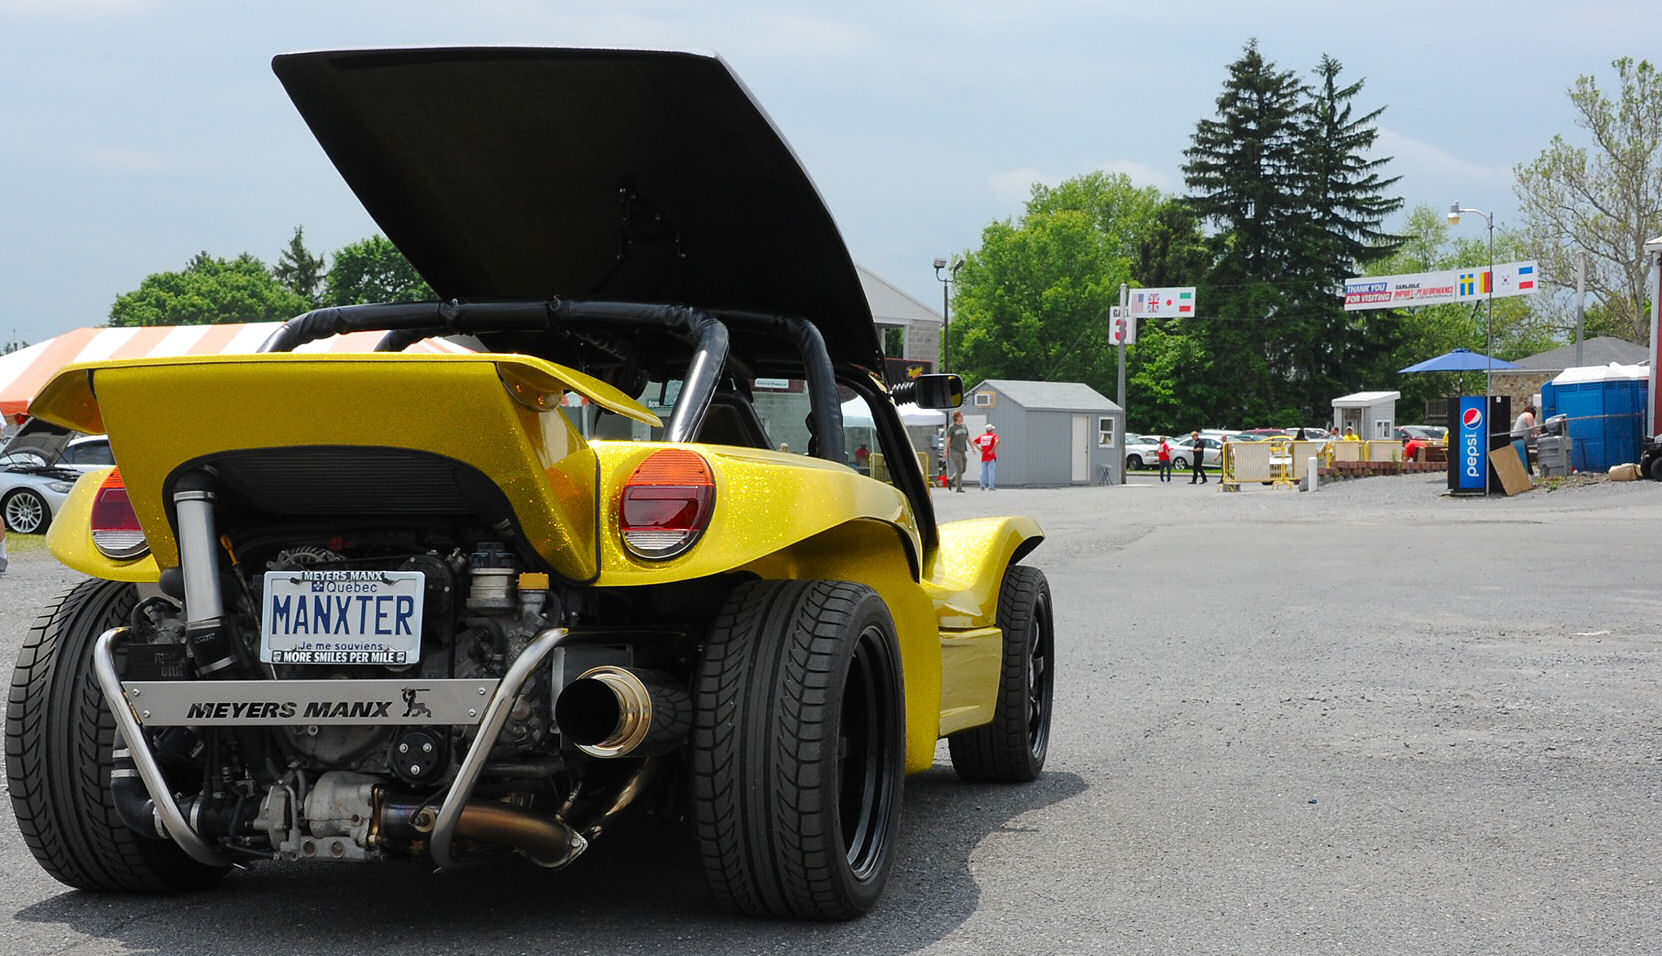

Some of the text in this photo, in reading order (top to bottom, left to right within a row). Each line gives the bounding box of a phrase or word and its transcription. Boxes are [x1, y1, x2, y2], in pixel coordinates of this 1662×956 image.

[1347, 283, 1386, 294] THANK YOU
[1346, 295, 1361, 304] FOR
[1361, 293, 1391, 303] VISITING
[1464, 432, 1480, 477] pepsi
[303, 572, 383, 581] MEYERS MANX
[272, 595, 414, 635] MANXTER
[300, 641, 312, 650] Je
[335, 642, 383, 651] souviens
[283, 652, 395, 662] MORE SMILES PER MILE
[187, 701, 393, 719] MEYERS MANX
